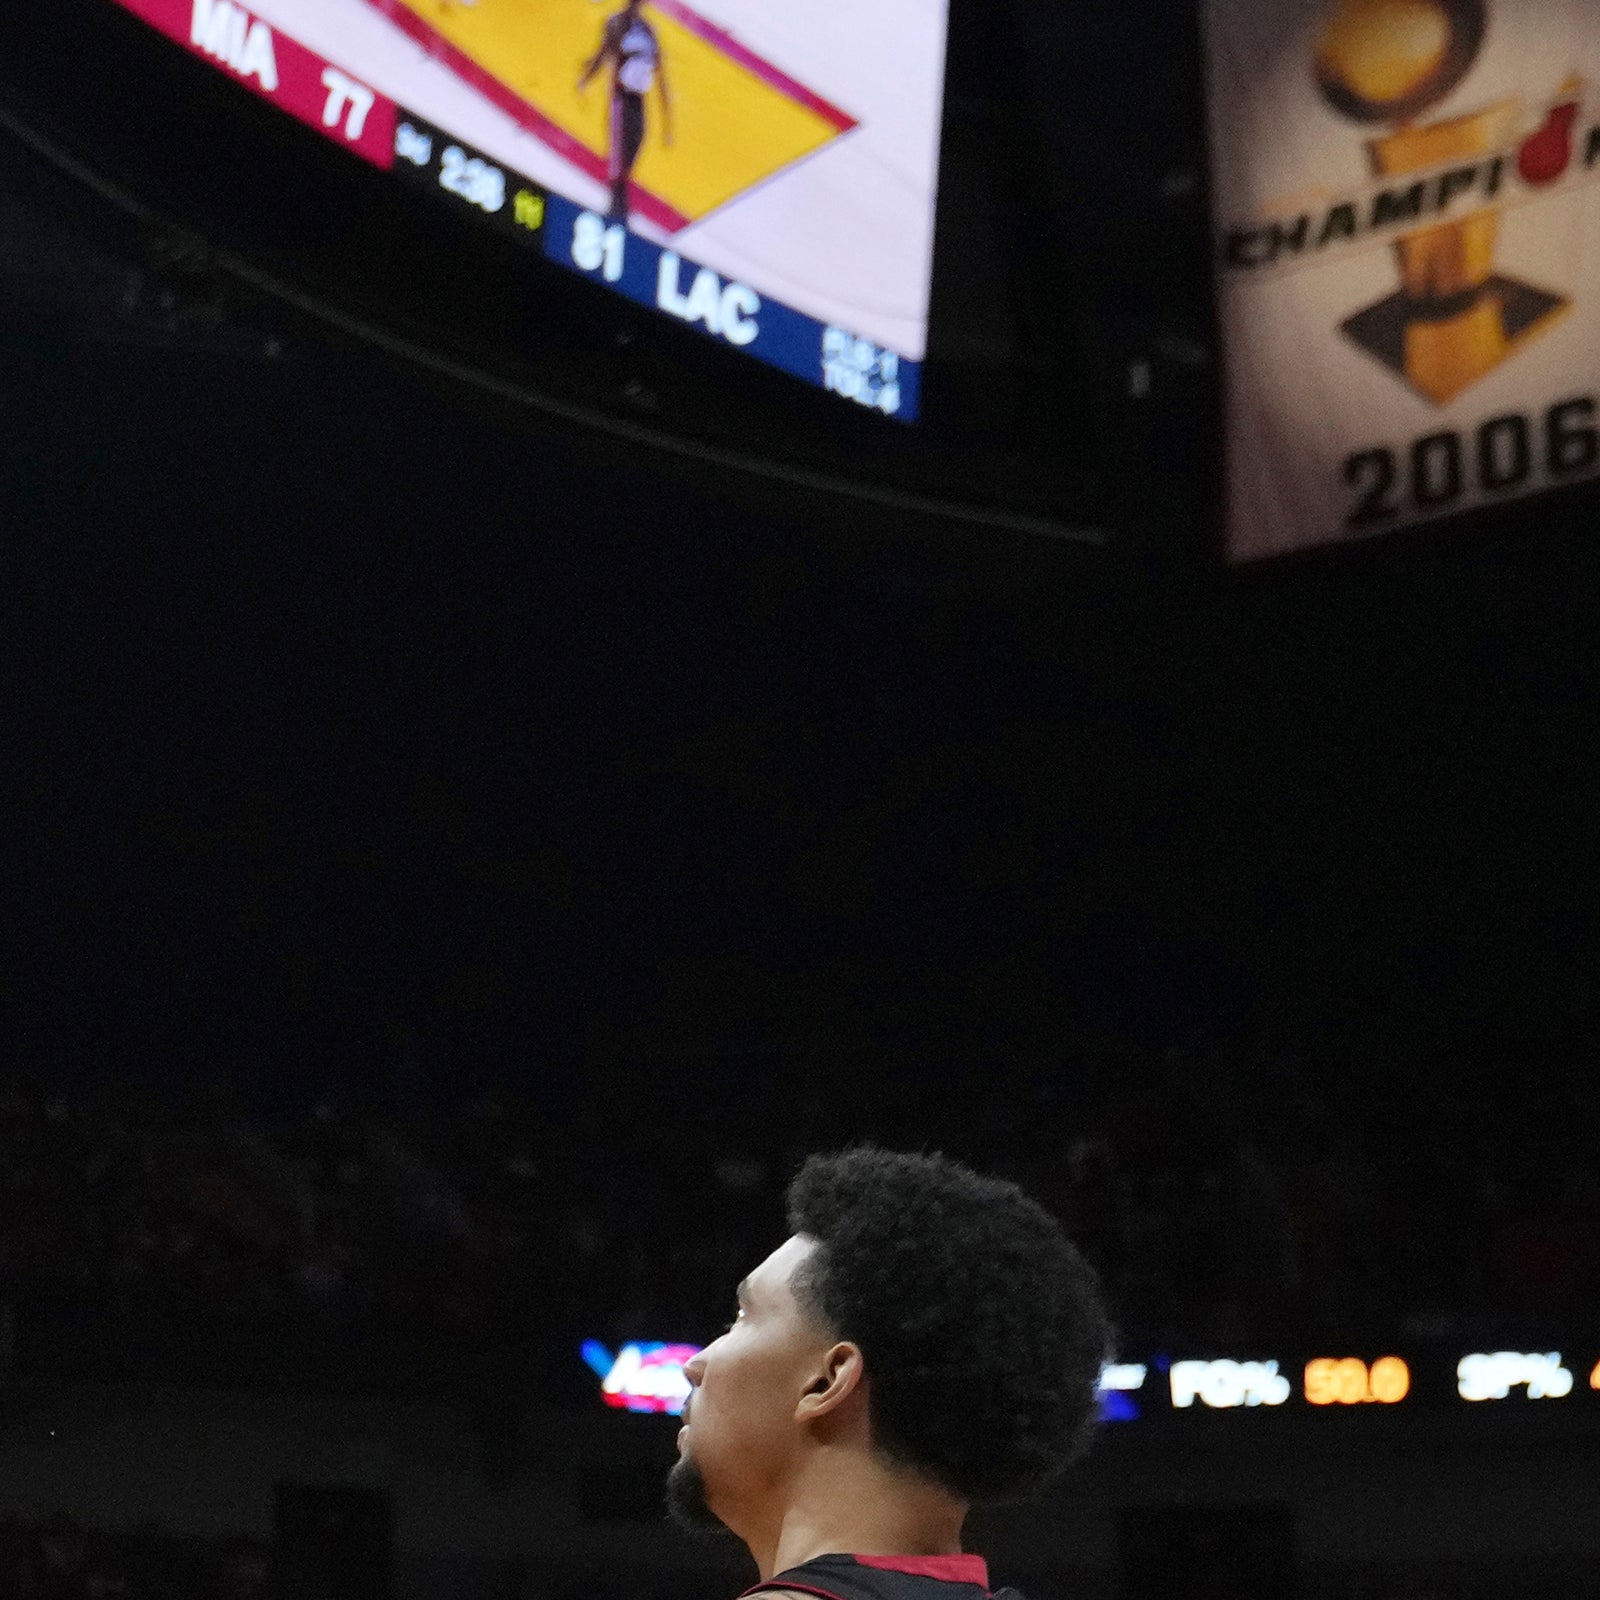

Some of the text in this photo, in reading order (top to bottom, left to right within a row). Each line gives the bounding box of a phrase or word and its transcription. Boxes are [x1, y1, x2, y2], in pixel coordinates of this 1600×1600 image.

[191, 0, 375, 140] MIA 77
[571, 208, 760, 346] 81 LAC
[1343, 396, 1600, 536] 2006
